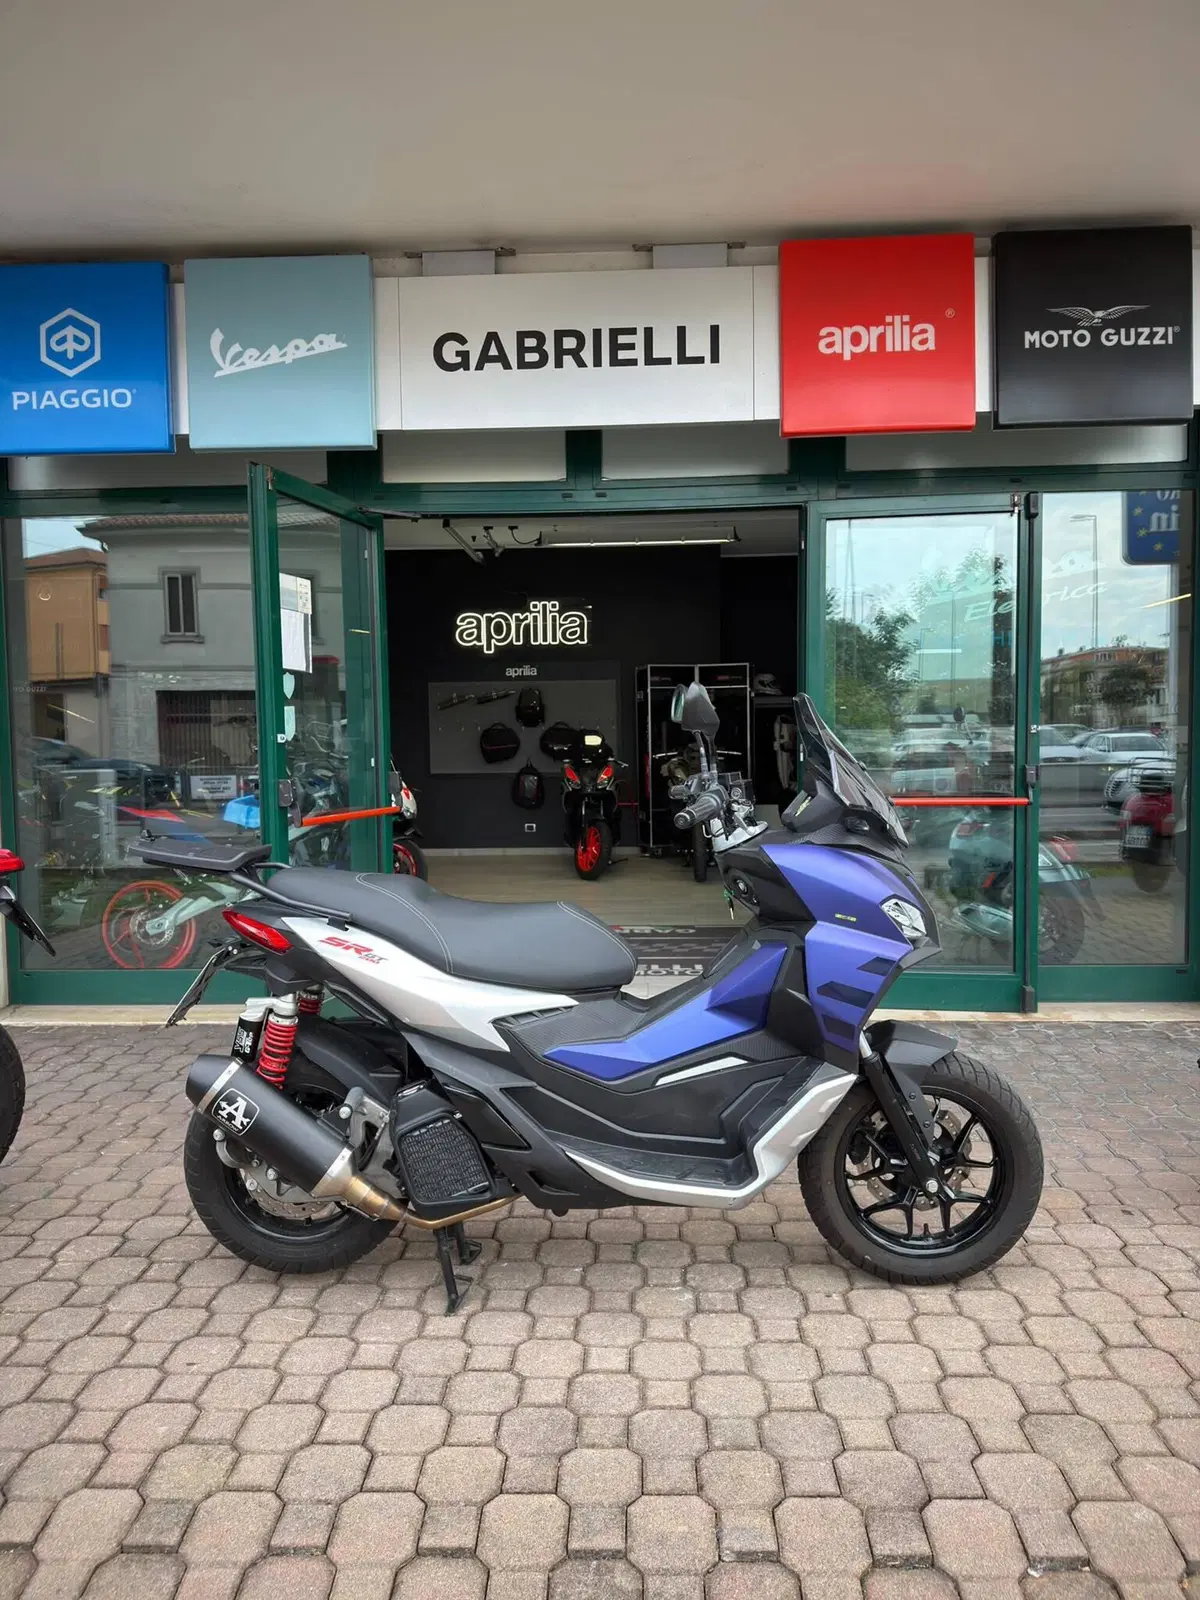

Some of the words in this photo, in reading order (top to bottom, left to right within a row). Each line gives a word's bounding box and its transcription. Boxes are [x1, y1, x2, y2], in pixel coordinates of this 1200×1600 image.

[433, 324, 720, 372] GABRIELLI
[818, 314, 936, 361] aprilia
[1023, 329, 1091, 349] MOTO
[1100, 326, 1173, 347] GUZZI
[209, 327, 348, 378] Vespa
[12, 388, 132, 410] PIAGGIO
[455, 601, 588, 654] aprilia
[505, 665, 537, 677] aprilia
[318, 936, 373, 955] SR
[216, 1115, 239, 1132] ARROW
